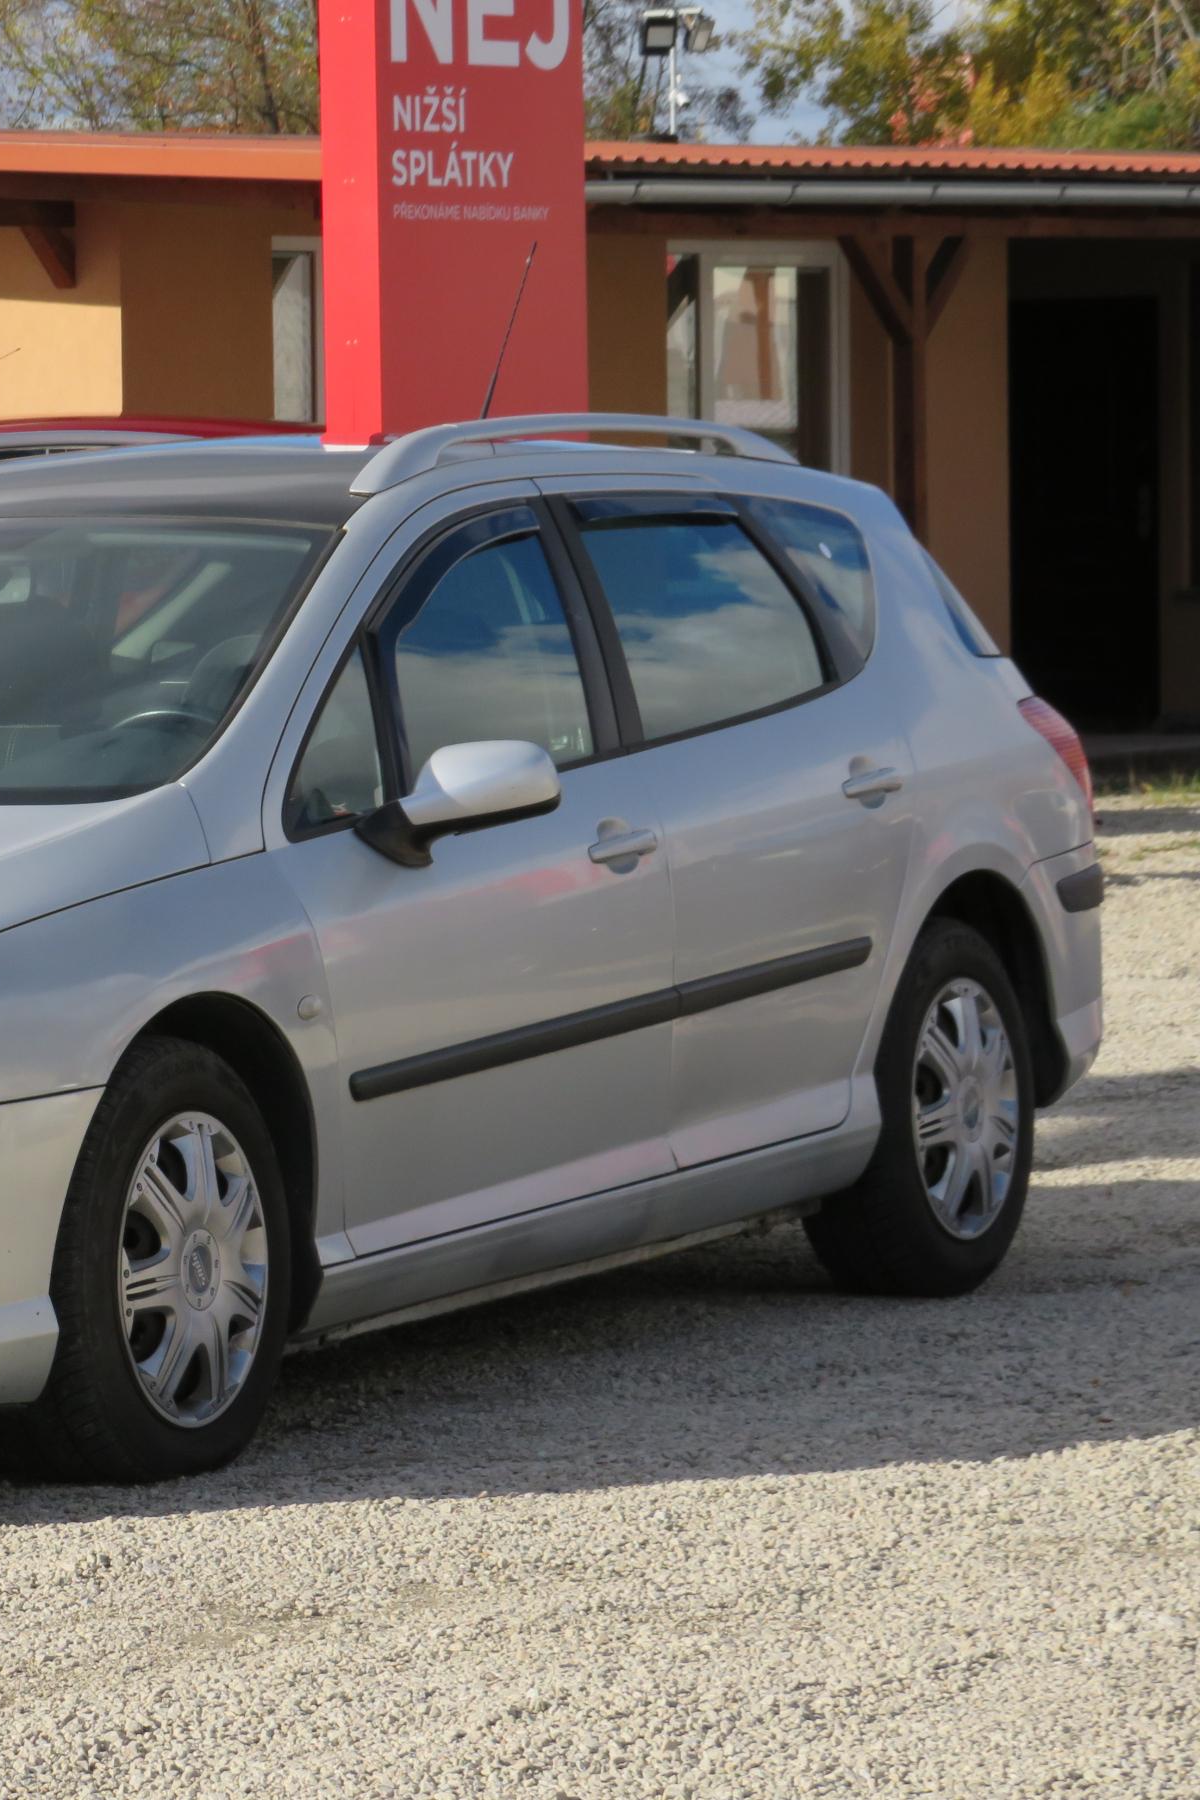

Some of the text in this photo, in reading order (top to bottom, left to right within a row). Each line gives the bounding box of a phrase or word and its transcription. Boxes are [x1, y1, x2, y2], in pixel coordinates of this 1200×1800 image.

[390, 0, 570, 71] NEJ
[392, 85, 467, 133] NIŽŠÍ
[391, 141, 514, 188] SPLÁTKY
[392, 201, 550, 221] PŘEKONÁME NABÍDKU BANKY
